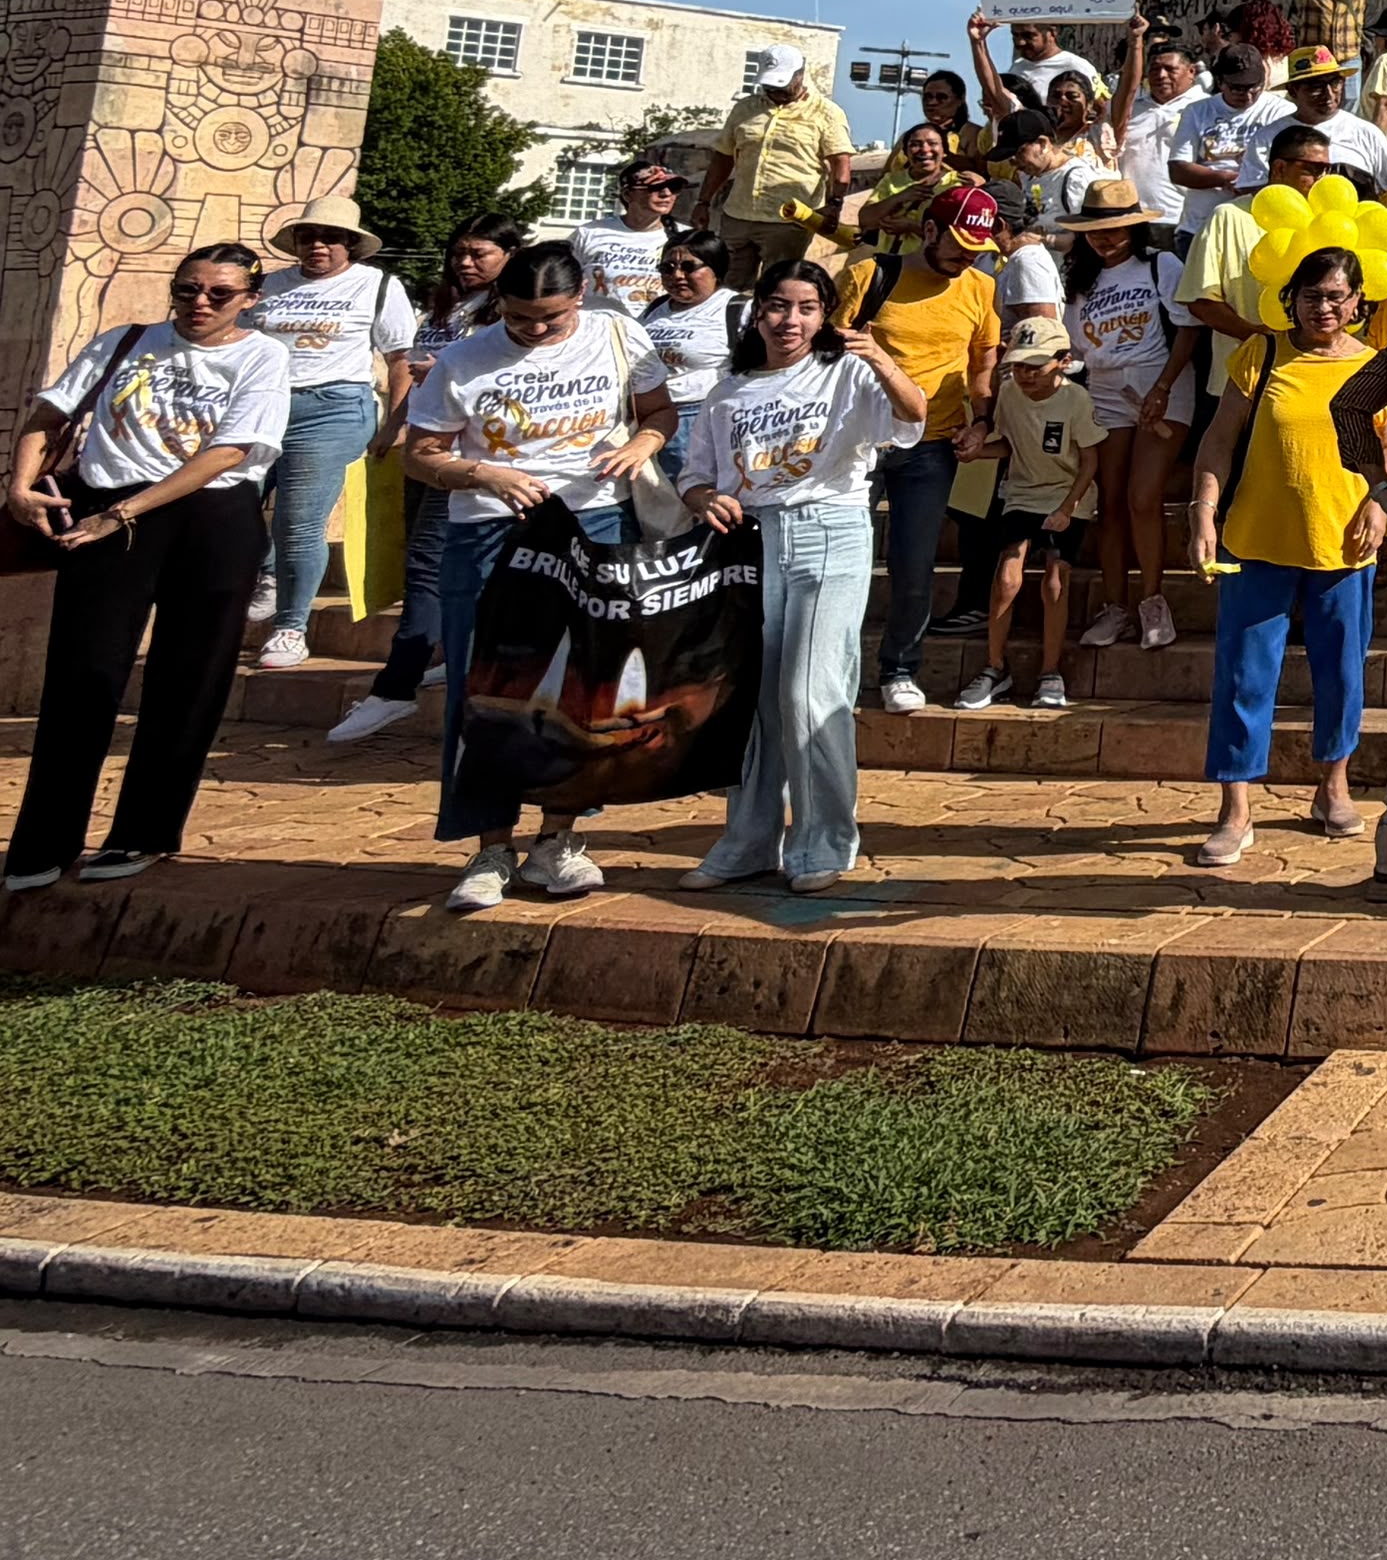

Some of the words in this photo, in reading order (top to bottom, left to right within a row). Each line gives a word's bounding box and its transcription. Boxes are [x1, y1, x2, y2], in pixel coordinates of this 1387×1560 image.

[992, 5, 1003, 16] te
[268, 299, 354, 316] speranza
[1080, 288, 1155, 321] speranza
[495, 370, 560, 388] Crear
[477, 375, 613, 417] esperanza
[573, 398, 590, 409] de
[592, 395, 604, 405] la
[522, 407, 609, 440] acción
[730, 401, 829, 450] speranza
[731, 399, 782, 424] Crear
[809, 421, 819, 430] la
[596, 563, 630, 585] SU
[636, 545, 704, 581] LUZ
[508, 546, 578, 601] BRILLE
[578, 594, 631, 620] POR
[640, 564, 759, 616] SIEMPRE
